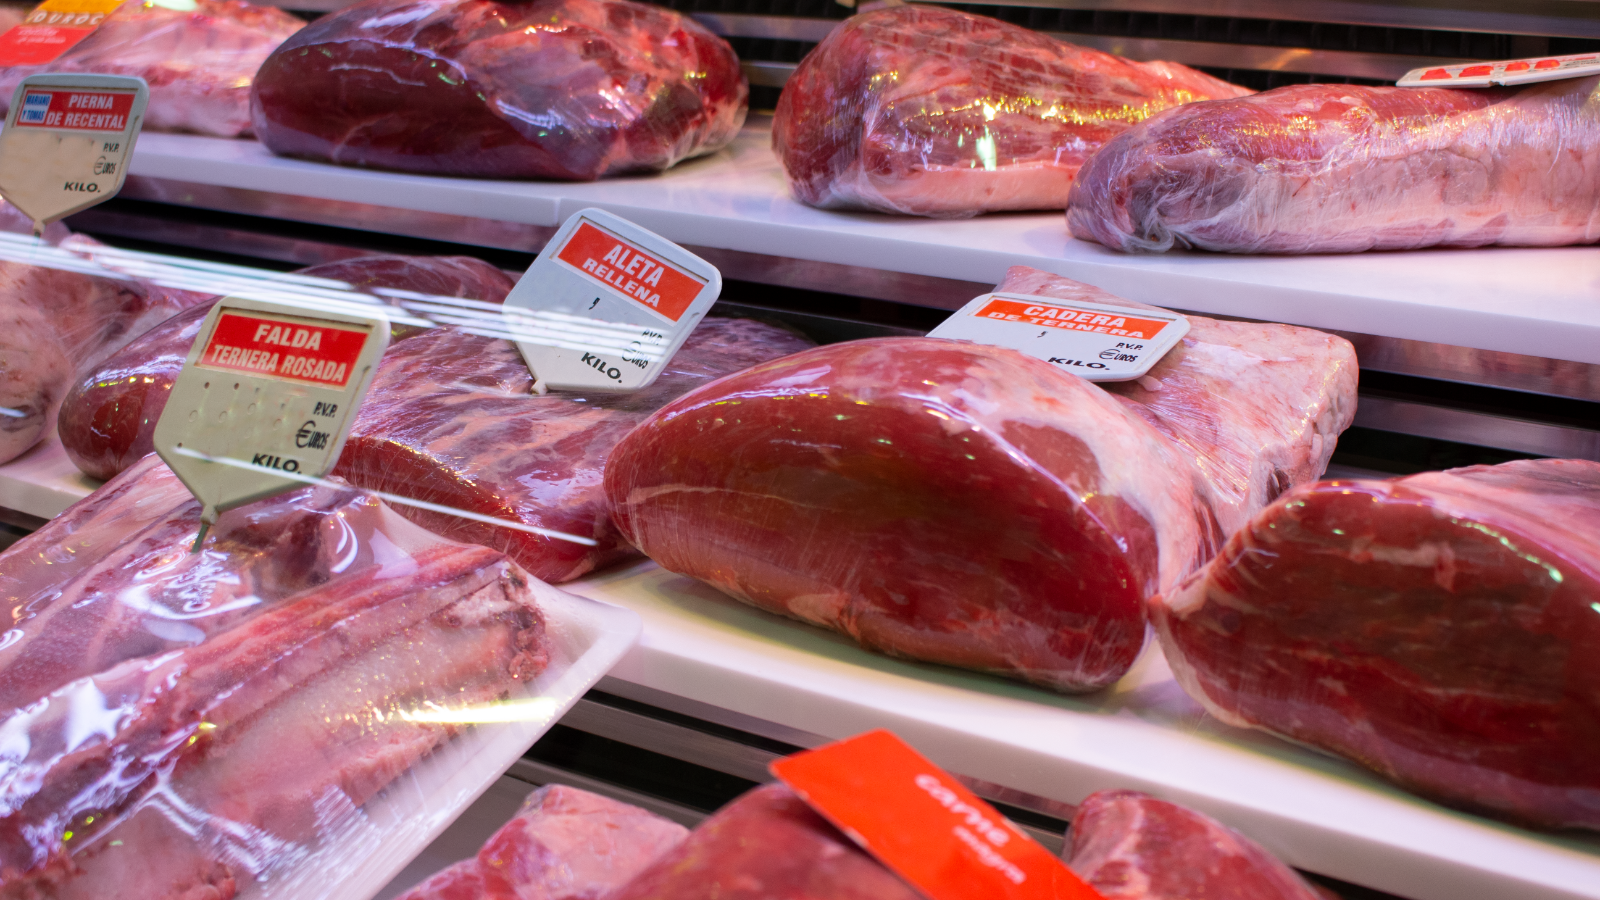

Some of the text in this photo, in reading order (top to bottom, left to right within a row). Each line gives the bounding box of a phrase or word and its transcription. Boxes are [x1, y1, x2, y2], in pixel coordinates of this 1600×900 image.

[68, 93, 114, 109] PIERNA
[46, 111, 124, 129] DE RECENTAL
[63, 181, 101, 193] KILO.
[603, 244, 665, 288] ALETA
[582, 257, 661, 308] RELLENA
[988, 312, 1144, 339] DE TERNERA
[1023, 306, 1127, 328] CADERA
[253, 323, 322, 351] FALDA
[211, 344, 347, 383] TERNERA ROSADA
[581, 352, 623, 384] KILO.
[1048, 357, 1110, 370] KILO.
[252, 453, 302, 475] KILO.
[914, 773, 1010, 847] carne
